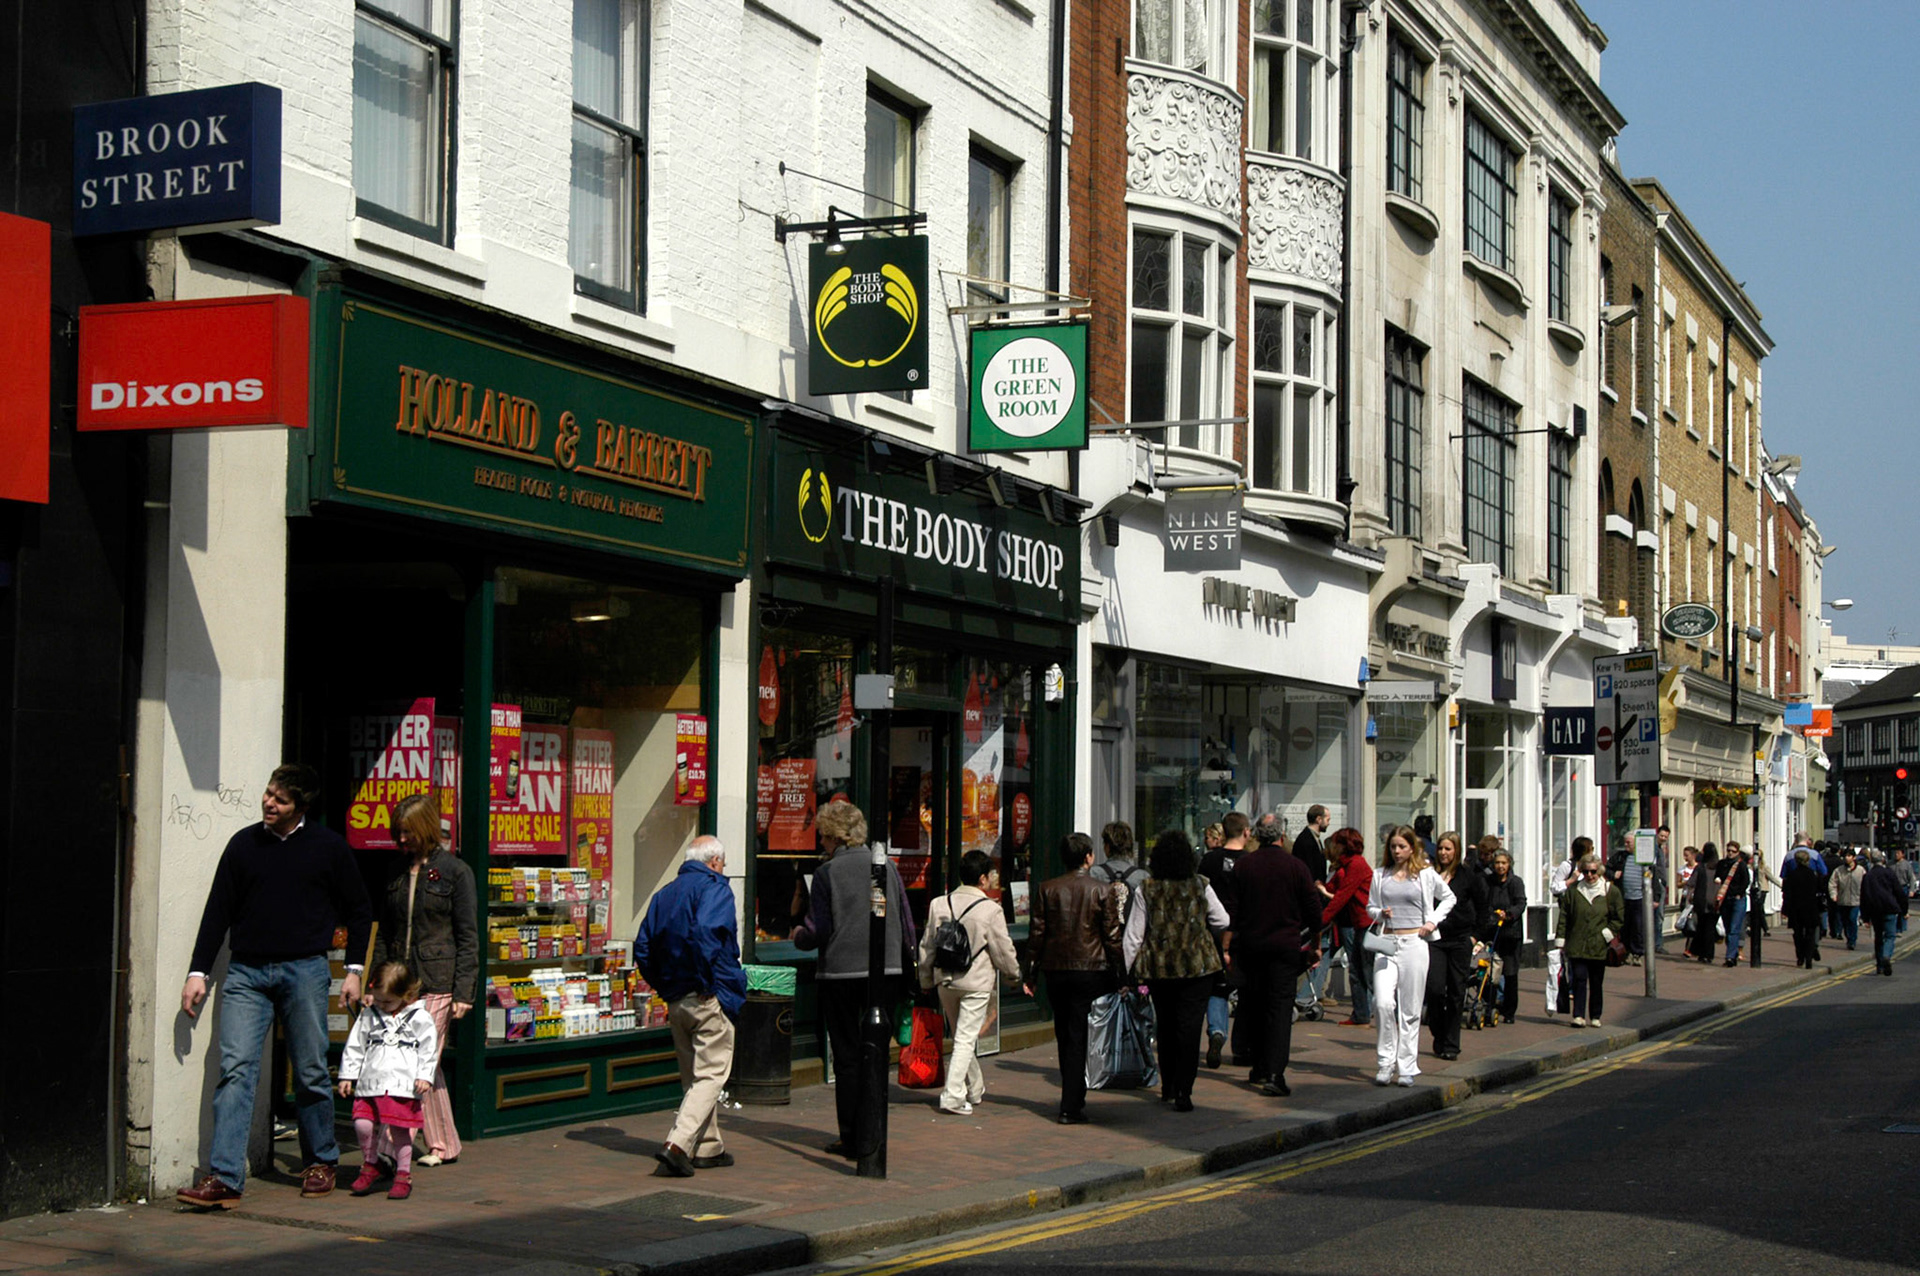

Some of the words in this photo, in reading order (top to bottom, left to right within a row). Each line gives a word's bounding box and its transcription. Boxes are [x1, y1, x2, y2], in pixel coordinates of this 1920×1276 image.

[96, 115, 229, 160] BROOK
[81, 160, 245, 208] STREET
[853, 273, 881, 283] THE
[850, 282, 884, 294] BODY
[850, 292, 884, 305] SHOP
[1008, 357, 1048, 374] THE
[91, 377, 264, 410] Dixons
[994, 377, 1061, 397] GREEN
[998, 400, 1057, 418] ROOM
[396, 365, 541, 453] HOLLAND
[555, 411, 581, 469] &
[594, 418, 712, 501] BARRETT
[1169, 510, 1238, 528] NINE
[837, 485, 909, 557] THE
[914, 506, 994, 575] BODY
[998, 530, 1064, 592] SHOP
[1169, 533, 1237, 551] WEST
[1596, 663, 1611, 673] Kew
[759, 685, 777, 700] new
[1613, 680, 1629, 689] 820
[1630, 679, 1655, 690] spaces
[965, 709, 981, 721] new
[1622, 702, 1645, 712] Sheen
[506, 710, 521, 728] THAN
[677, 719, 694, 734] BETTER
[695, 720, 707, 736] THAN
[349, 714, 430, 748] BETTER
[1551, 717, 1586, 744] GAP
[1805, 727, 1829, 735] orange
[1623, 738, 1639, 748] 530
[1623, 746, 1649, 757] spaces
[574, 739, 612, 768] BETTER
[349, 750, 430, 779] THAN
[574, 769, 612, 793] THAN
[349, 780, 385, 802] HALF
[387, 780, 430, 802] PRICE
[779, 793, 806, 803] FREE
[349, 803, 392, 829] SA
[497, 815, 532, 841] PRICE
[534, 815, 562, 842] SALE
